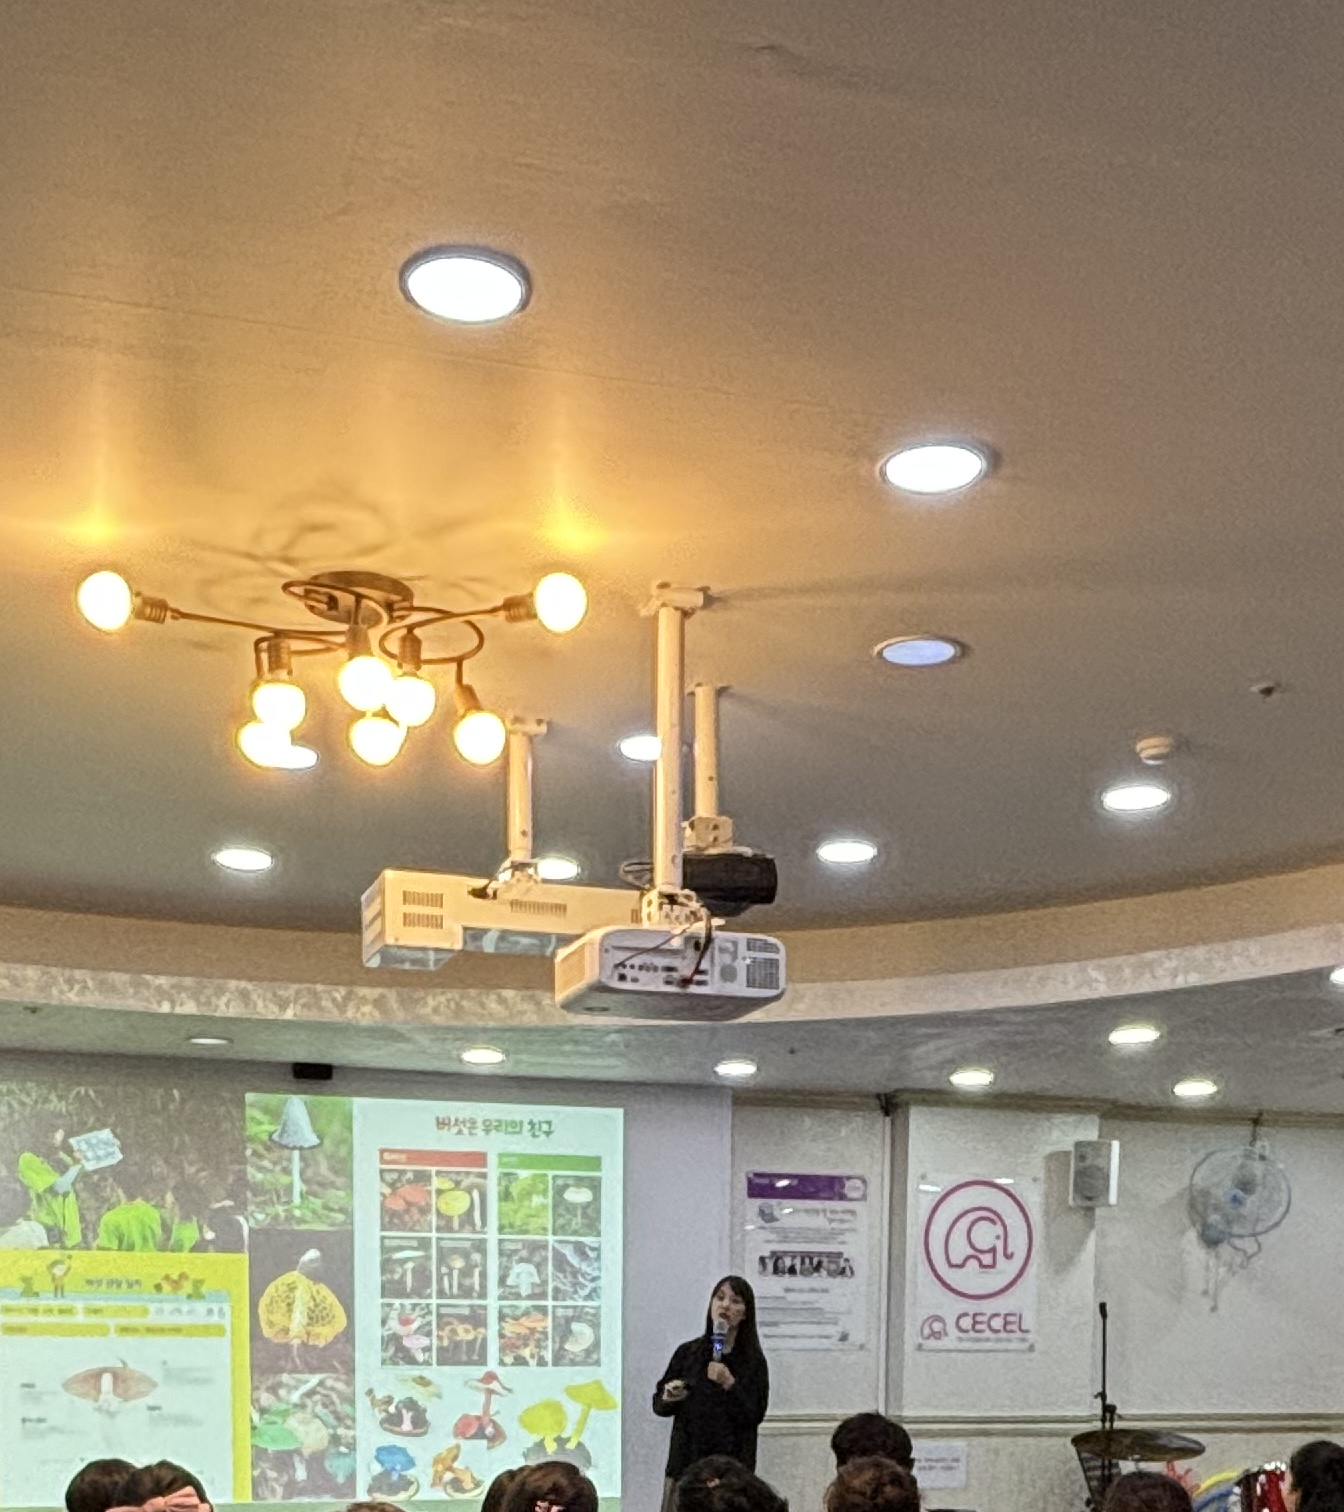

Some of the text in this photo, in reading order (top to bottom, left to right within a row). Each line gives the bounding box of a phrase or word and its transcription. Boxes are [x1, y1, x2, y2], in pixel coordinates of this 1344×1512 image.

[435, 1115, 478, 1136] 버섯은
[527, 1118, 555, 1138] 친구
[955, 1312, 1031, 1334] CECEL
